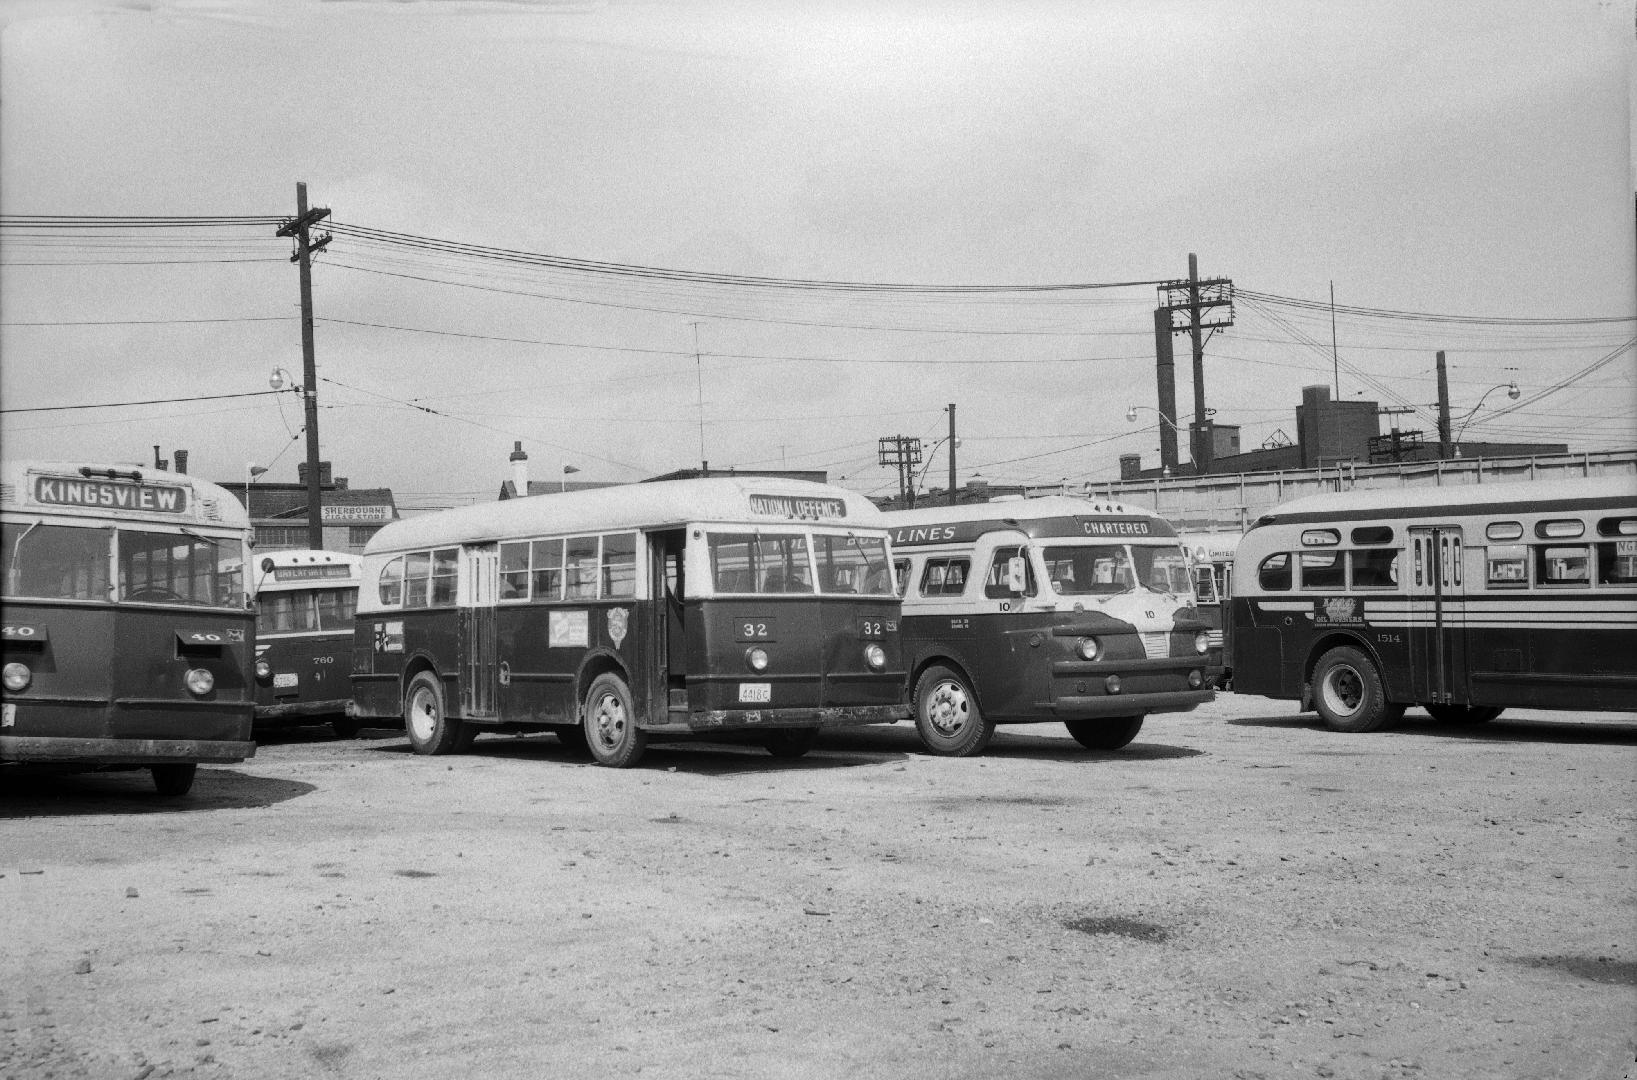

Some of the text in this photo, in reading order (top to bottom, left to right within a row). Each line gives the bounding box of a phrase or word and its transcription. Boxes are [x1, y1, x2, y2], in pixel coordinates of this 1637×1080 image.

[40, 480, 177, 510] KINGSVIEW
[325, 507, 387, 515] SHERBOURNE
[796, 500, 841, 517] DEFENCE
[1084, 522, 1148, 534] CHARTERED
[896, 526, 956, 543] LINES
[1208, 549, 1235, 558] LIMITED
[999, 602, 1010, 611] 10
[1144, 610, 1155, 619] 10
[1, 626, 35, 636] 40
[743, 623, 768, 637] 32
[864, 621, 881, 635] 32
[191, 633, 221, 641] 40
[1377, 634, 1401, 643] 1514
[312, 656, 334, 665] 760
